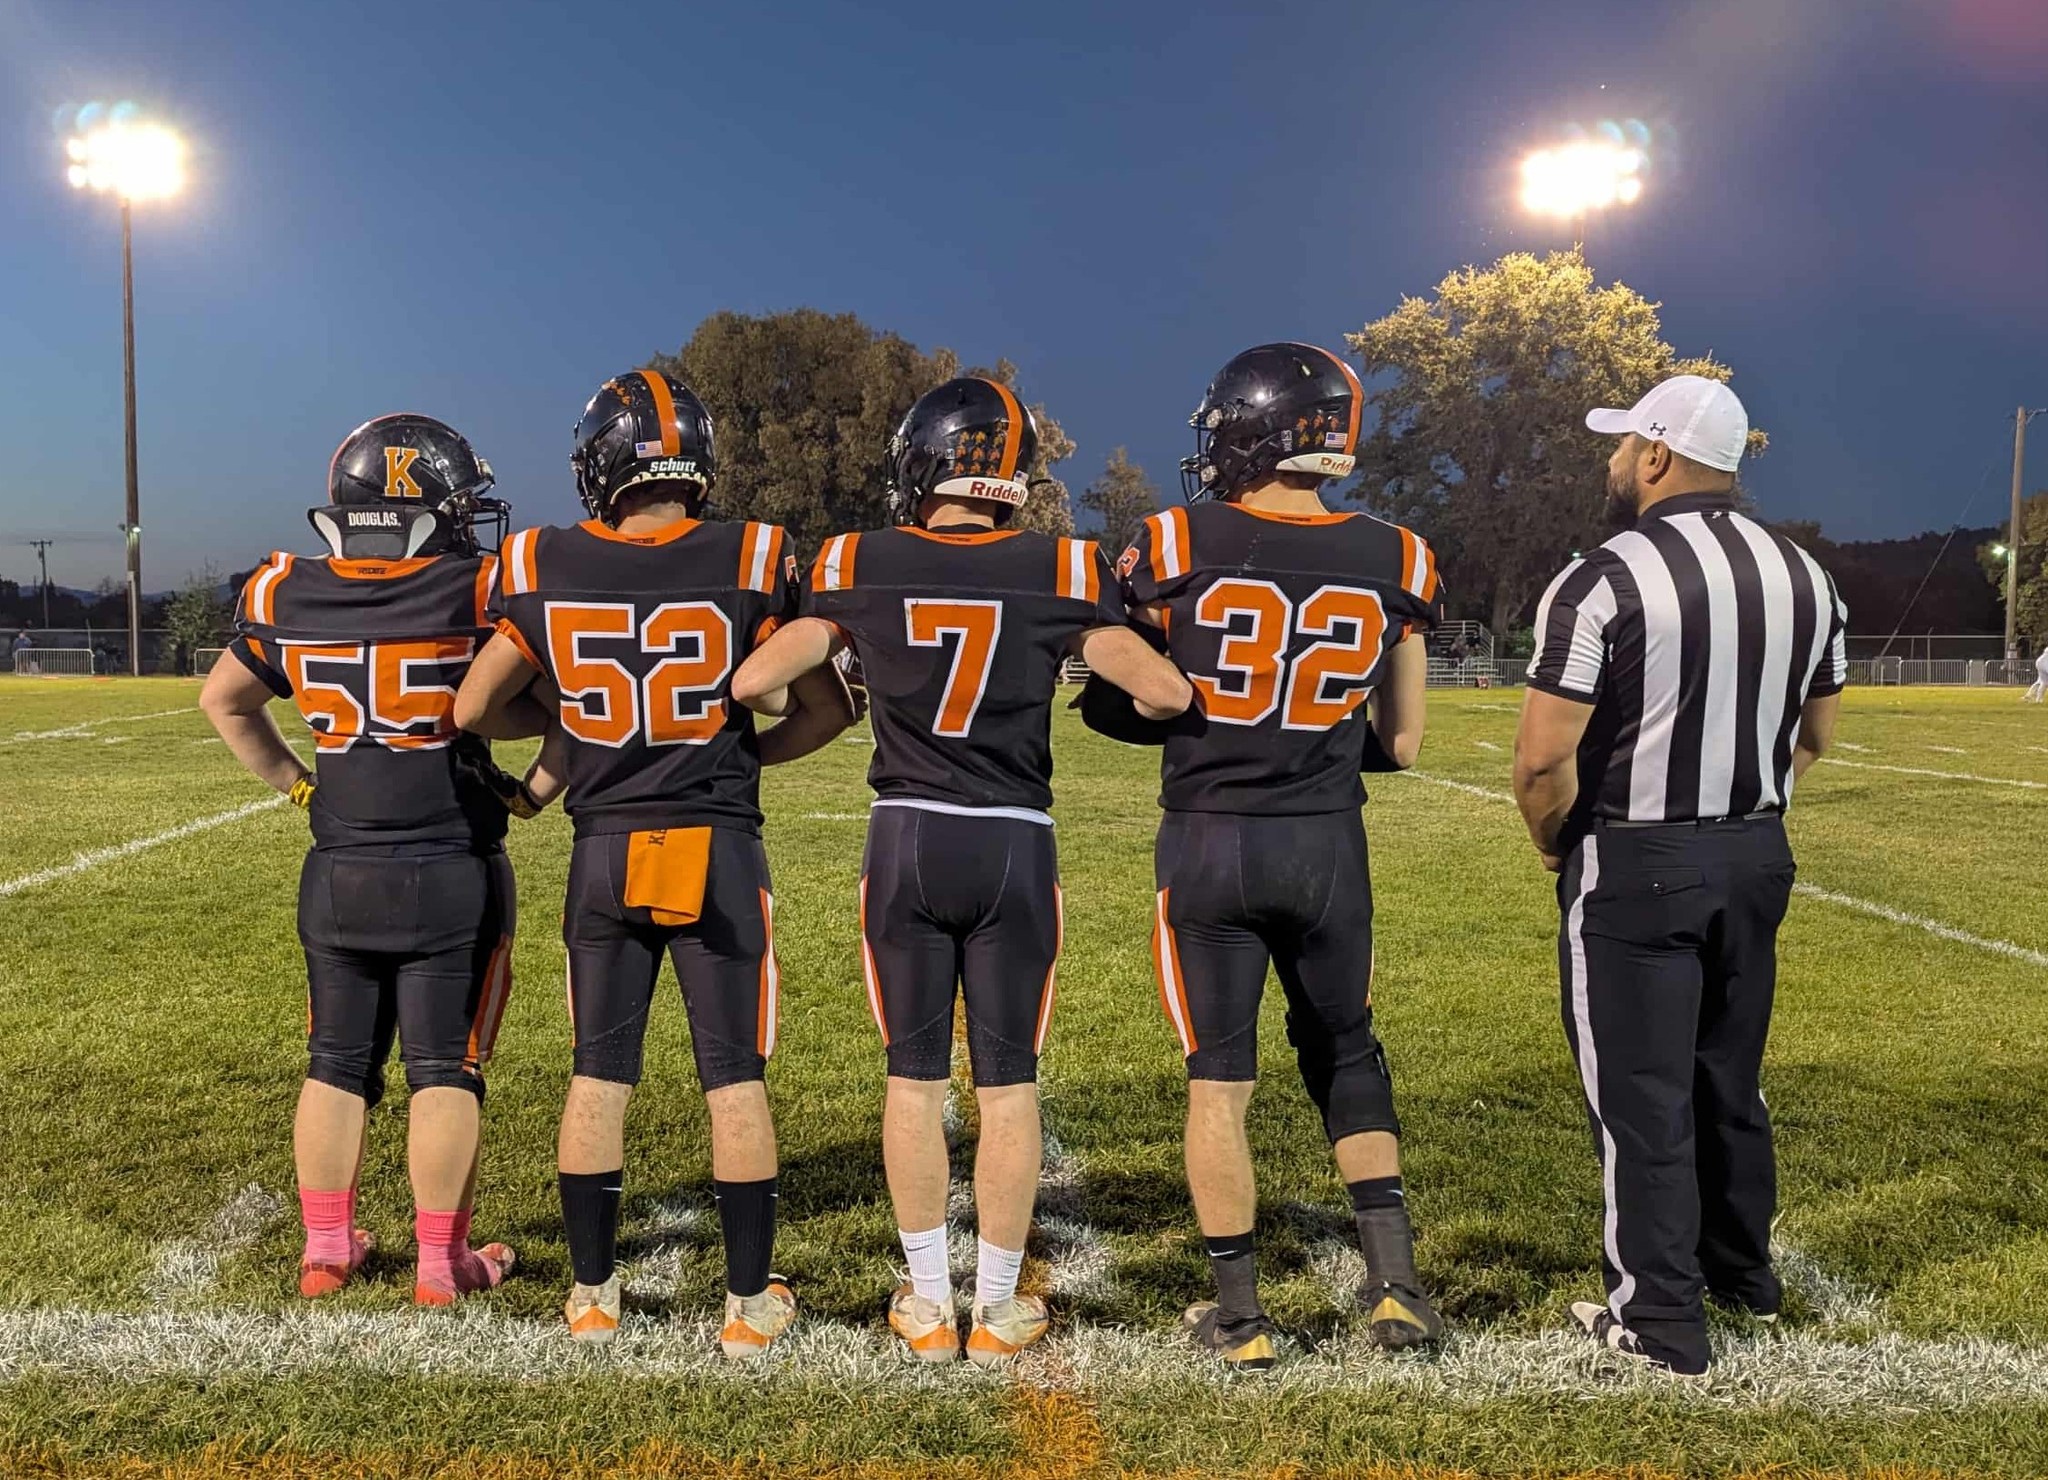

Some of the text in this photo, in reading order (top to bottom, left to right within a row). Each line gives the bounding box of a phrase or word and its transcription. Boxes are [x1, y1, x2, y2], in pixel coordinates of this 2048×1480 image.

[384, 446, 422, 498] K
[649, 457, 697, 474] schutt
[969, 480, 1026, 504] Riddell
[274, 636, 477, 755] 55
[544, 601, 733, 749] 52
[903, 597, 1003, 739] 7
[1186, 577, 1389, 732] 32
